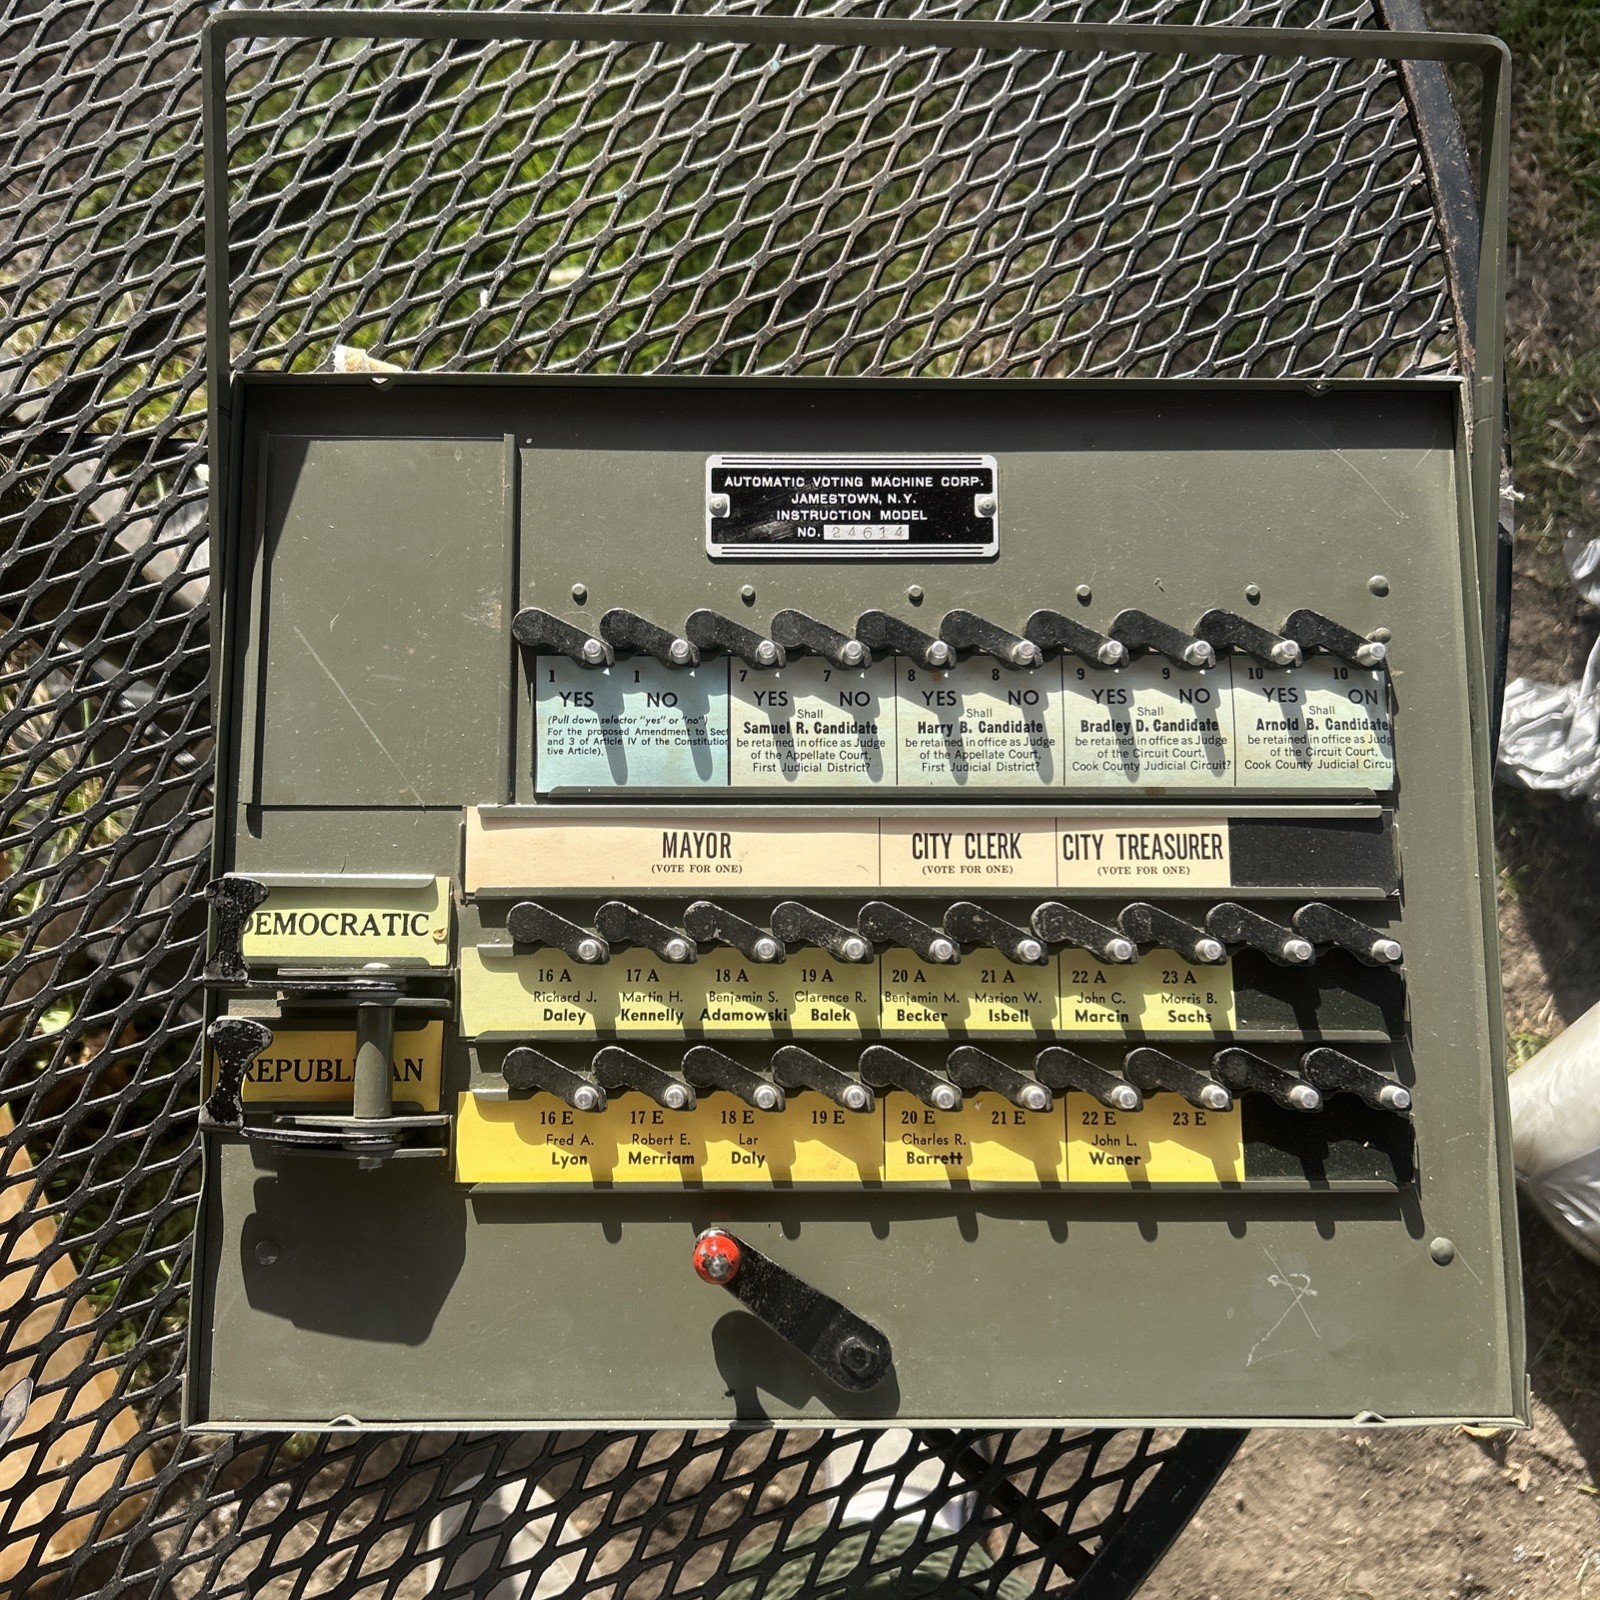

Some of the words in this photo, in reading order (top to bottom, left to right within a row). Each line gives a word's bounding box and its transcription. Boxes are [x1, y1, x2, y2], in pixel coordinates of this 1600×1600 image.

[724, 476, 805, 487] AUTOMATIC
[812, 477, 863, 488] VOTING
[871, 477, 933, 488] MACHINE
[940, 477, 984, 488] CORP.
[791, 494, 883, 506] JAMESTOWN,
[776, 510, 871, 521] INSTRUCTION
[880, 510, 928, 521] MODEL
[797, 527, 820, 538] NO.
[831, 527, 903, 538] 24614
[549, 670, 555, 683] 1
[634, 670, 640, 683] 1
[739, 670, 748, 682] 7
[823, 670, 832, 682] 7
[907, 669, 916, 682] 8
[991, 668, 1000, 681] 8
[1076, 668, 1085, 680] 9
[1162, 668, 1170, 680] 9
[1247, 668, 1264, 680] 10
[1333, 668, 1349, 680] 10
[559, 692, 594, 708] YES
[646, 692, 678, 708] NO
[753, 691, 789, 707] YES
[839, 691, 871, 707] NO
[922, 690, 957, 706] YES
[1008, 690, 1039, 706] NO
[1091, 689, 1127, 705] YES
[1179, 688, 1211, 704] NO
[1262, 687, 1298, 703] YES
[547, 715, 569, 726] (Pull
[572, 715, 598, 724] down
[600, 716, 637, 725] selector
[797, 709, 823, 719] Shall
[743, 722, 790, 735] Samuel
[796, 722, 809, 734] R.
[813, 722, 878, 735] Candidate
[918, 721, 953, 737] Harry
[960, 721, 972, 734] B.
[978, 720, 1043, 733] Candidate
[1081, 719, 1131, 736] Bradley
[1136, 720, 1149, 732] D.
[1153, 718, 1219, 732] Candidate
[1256, 718, 1299, 731] Arnold
[1306, 718, 1319, 731] B.
[1325, 718, 1388, 731] Candidate
[736, 738, 749, 748] be
[751, 738, 794, 748] retained
[797, 738, 806, 748] in
[808, 738, 839, 748] office
[840, 740, 852, 748] as
[854, 738, 885, 749] Judge
[750, 750, 762, 760] of
[765, 750, 782, 760] the
[786, 750, 836, 763] Appellate
[839, 750, 872, 761] Court,
[1097, 749, 1108, 759] of
[1112, 749, 1129, 758] the
[1133, 748, 1169, 759] Circuit
[753, 763, 776, 773] First
[781, 763, 822, 773] Judicial
[827, 763, 871, 773] District?
[1072, 761, 1098, 771] Cook
[1102, 761, 1140, 773] County
[1144, 761, 1186, 771] Judicial
[1190, 760, 1231, 770] Circuit?
[662, 831, 732, 859] MAYOR
[912, 832, 951, 860] CITY
[964, 832, 1023, 860] CLERK
[1062, 834, 1104, 861] CITY
[1115, 833, 1224, 861] TREASURER
[651, 864, 685, 874] (VOTE
[689, 864, 711, 873] FOR
[715, 864, 743, 874] ONE)
[922, 865, 955, 876] (VOTE
[960, 865, 982, 874] FOR
[986, 865, 1014, 875] ONE)
[1097, 866, 1132, 876] (VOTE
[1136, 866, 1158, 875] FOR
[1162, 866, 1191, 876] ONE)
[538, 969, 554, 982] 16
[559, 969, 572, 982] A
[627, 969, 641, 982] 17
[647, 969, 660, 982] A
[716, 969, 731, 983] 18
[736, 969, 749, 982] A
[801, 969, 817, 983] 19
[821, 969, 834, 982] A
[892, 969, 908, 983] 20
[914, 969, 926, 983] A
[981, 970, 996, 983] 21
[1002, 969, 1015, 983] A
[1072, 971, 1089, 984] 22
[1094, 970, 1107, 984] A
[1162, 971, 1178, 984] 23
[1184, 970, 1197, 984] A
[534, 991, 581, 1003] Richard
[586, 991, 597, 1003] J.
[622, 991, 663, 1003] Martin
[669, 991, 683, 1003] H.
[709, 991, 763, 1005] Benjamin
[768, 991, 779, 1003] S.
[794, 991, 849, 1003] Clarence
[855, 991, 867, 1003] R.
[885, 991, 938, 1006] Benjamin
[943, 992, 960, 1003] M.
[974, 992, 1018, 1004] Marion
[1024, 992, 1042, 1004] W.
[1076, 992, 1106, 1004] John
[1111, 992, 1126, 1004] C.
[1161, 993, 1201, 1004] Morris
[1206, 993, 1218, 1004] B.
[543, 1008, 586, 1025] Daley
[620, 1008, 684, 1025] Kennelly
[699, 1008, 788, 1022] Adamowski
[811, 1008, 851, 1022] Balek
[897, 1009, 948, 1022] Becker
[989, 1009, 1029, 1022] Isbell
[1075, 1009, 1129, 1023] Marcin
[1168, 1010, 1212, 1023] Sachs
[540, 1111, 556, 1125] 16
[561, 1111, 574, 1125] E
[630, 1110, 646, 1124] 17
[651, 1110, 664, 1124] E
[721, 1110, 737, 1124] 18
[742, 1110, 755, 1124] E
[901, 1111, 918, 1124] 20
[924, 1111, 935, 1124] E
[1082, 1112, 1098, 1126] 22
[1104, 1112, 1116, 1126] E
[1173, 1112, 1189, 1126] 23
[1194, 1112, 1207, 1126] E
[546, 1133, 574, 1146] Fred
[580, 1134, 594, 1146] A.
[632, 1133, 674, 1146] Robert
[680, 1133, 691, 1146] E.
[739, 1133, 758, 1146] Lar
[901, 1133, 949, 1146] Charles
[954, 1133, 966, 1146] R.
[1091, 1134, 1120, 1146] John
[1126, 1134, 1137, 1146] L.
[552, 1151, 588, 1169] Lyon
[629, 1151, 695, 1165] Merriam
[731, 1151, 766, 1168] Daly
[907, 1152, 963, 1165] Barrett
[1088, 1152, 1141, 1165] Waner
